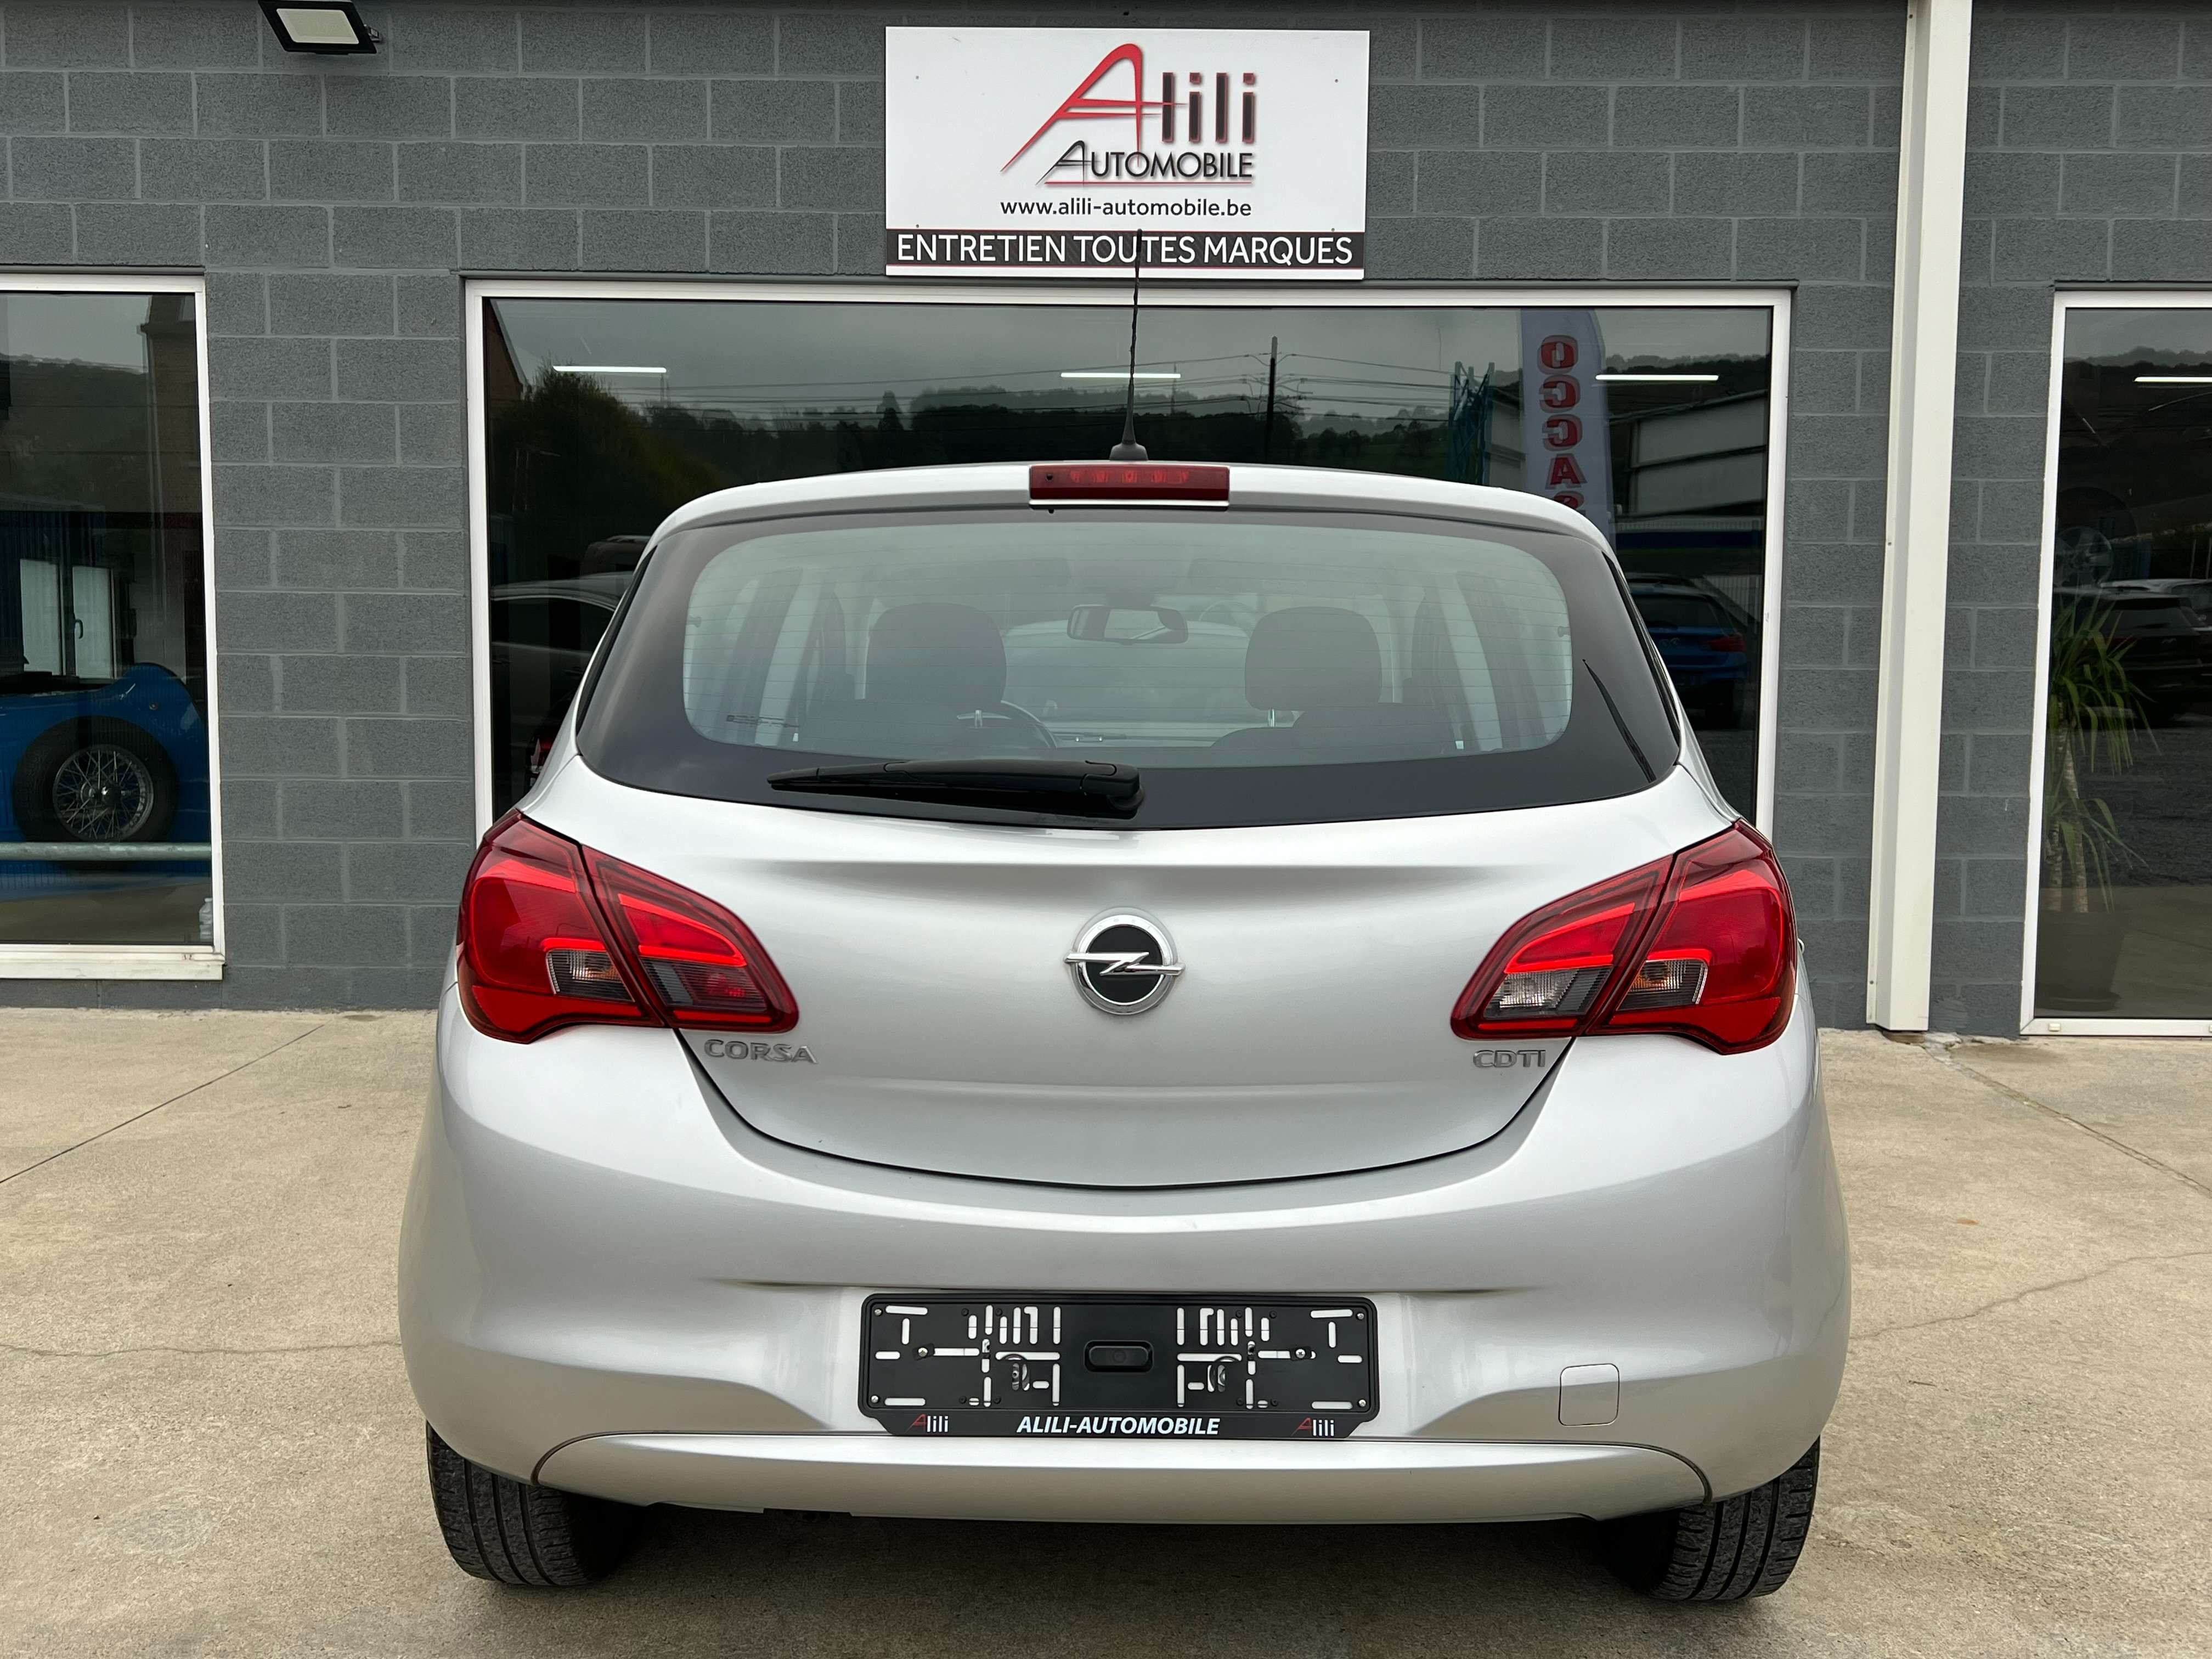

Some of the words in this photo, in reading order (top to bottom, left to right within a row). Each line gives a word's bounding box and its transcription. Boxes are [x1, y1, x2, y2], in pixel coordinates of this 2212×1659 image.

[1000, 43, 1256, 172] Alili
[1036, 140, 1253, 187] AUTOMOBILE
[1000, 198, 1252, 217] www.alili-automobile.be
[898, 234, 1065, 263] ENTRETIEN
[1073, 235, 1196, 263] TOUTES
[1204, 236, 1353, 266] MARQUES
[704, 1039, 819, 1064] CORSA
[1472, 1049, 1546, 1068] CDTI
[905, 1413, 949, 1432] Alili
[1017, 1415, 1221, 1435] ALILI-AUTOMOBILE
[1290, 1417, 1335, 1436] Alili
